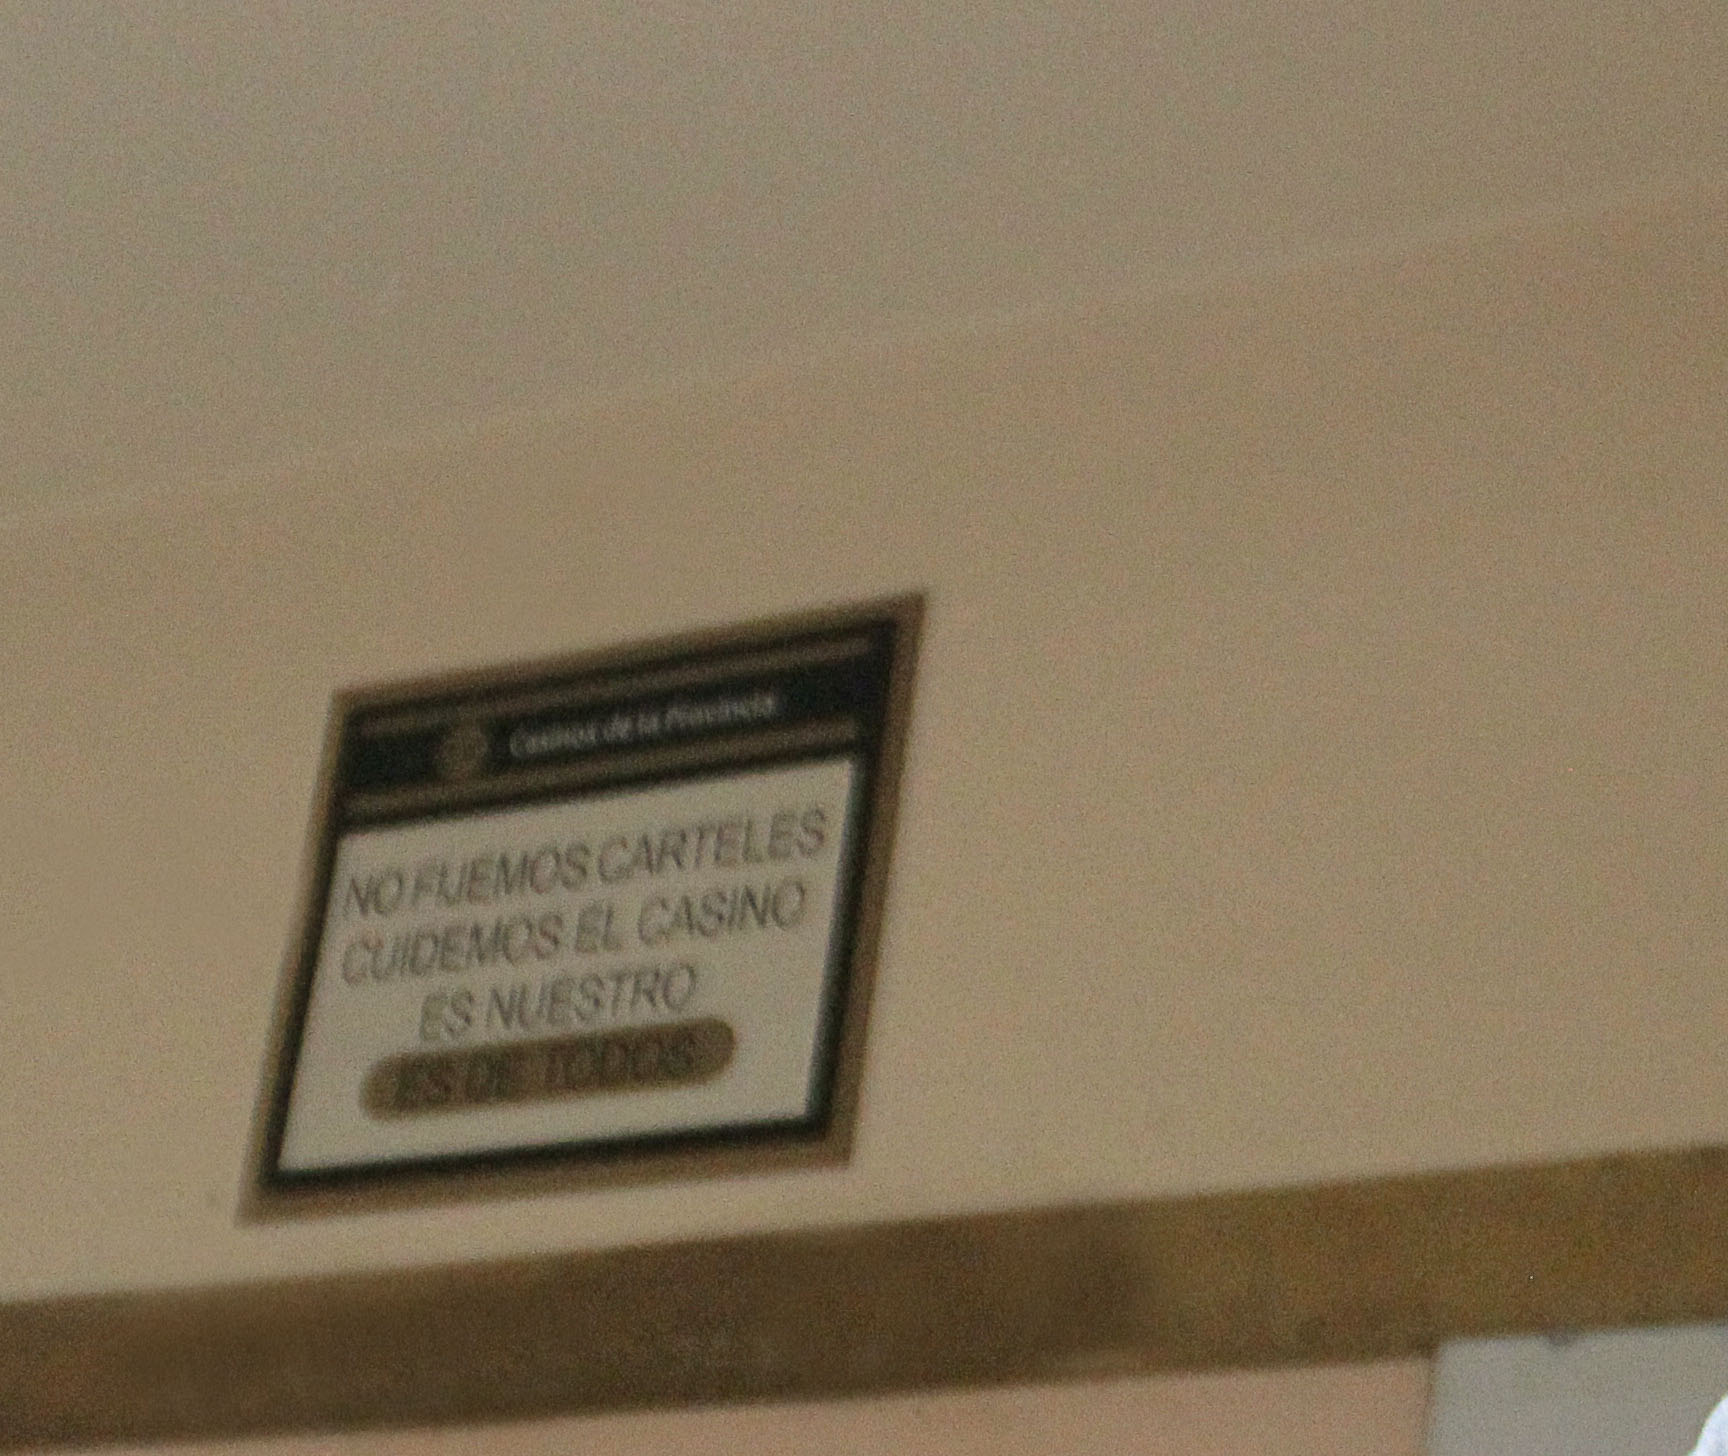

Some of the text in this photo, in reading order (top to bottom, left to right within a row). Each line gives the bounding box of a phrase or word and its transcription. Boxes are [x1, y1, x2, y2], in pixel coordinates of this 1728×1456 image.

[344, 808, 828, 920] NO FUEMOS CARTELES
[341, 876, 806, 987] CUIDEMOS EL CASINO
[419, 960, 699, 1042] ES NUESTRO
[394, 1029, 698, 1110] ES DE TODOS
